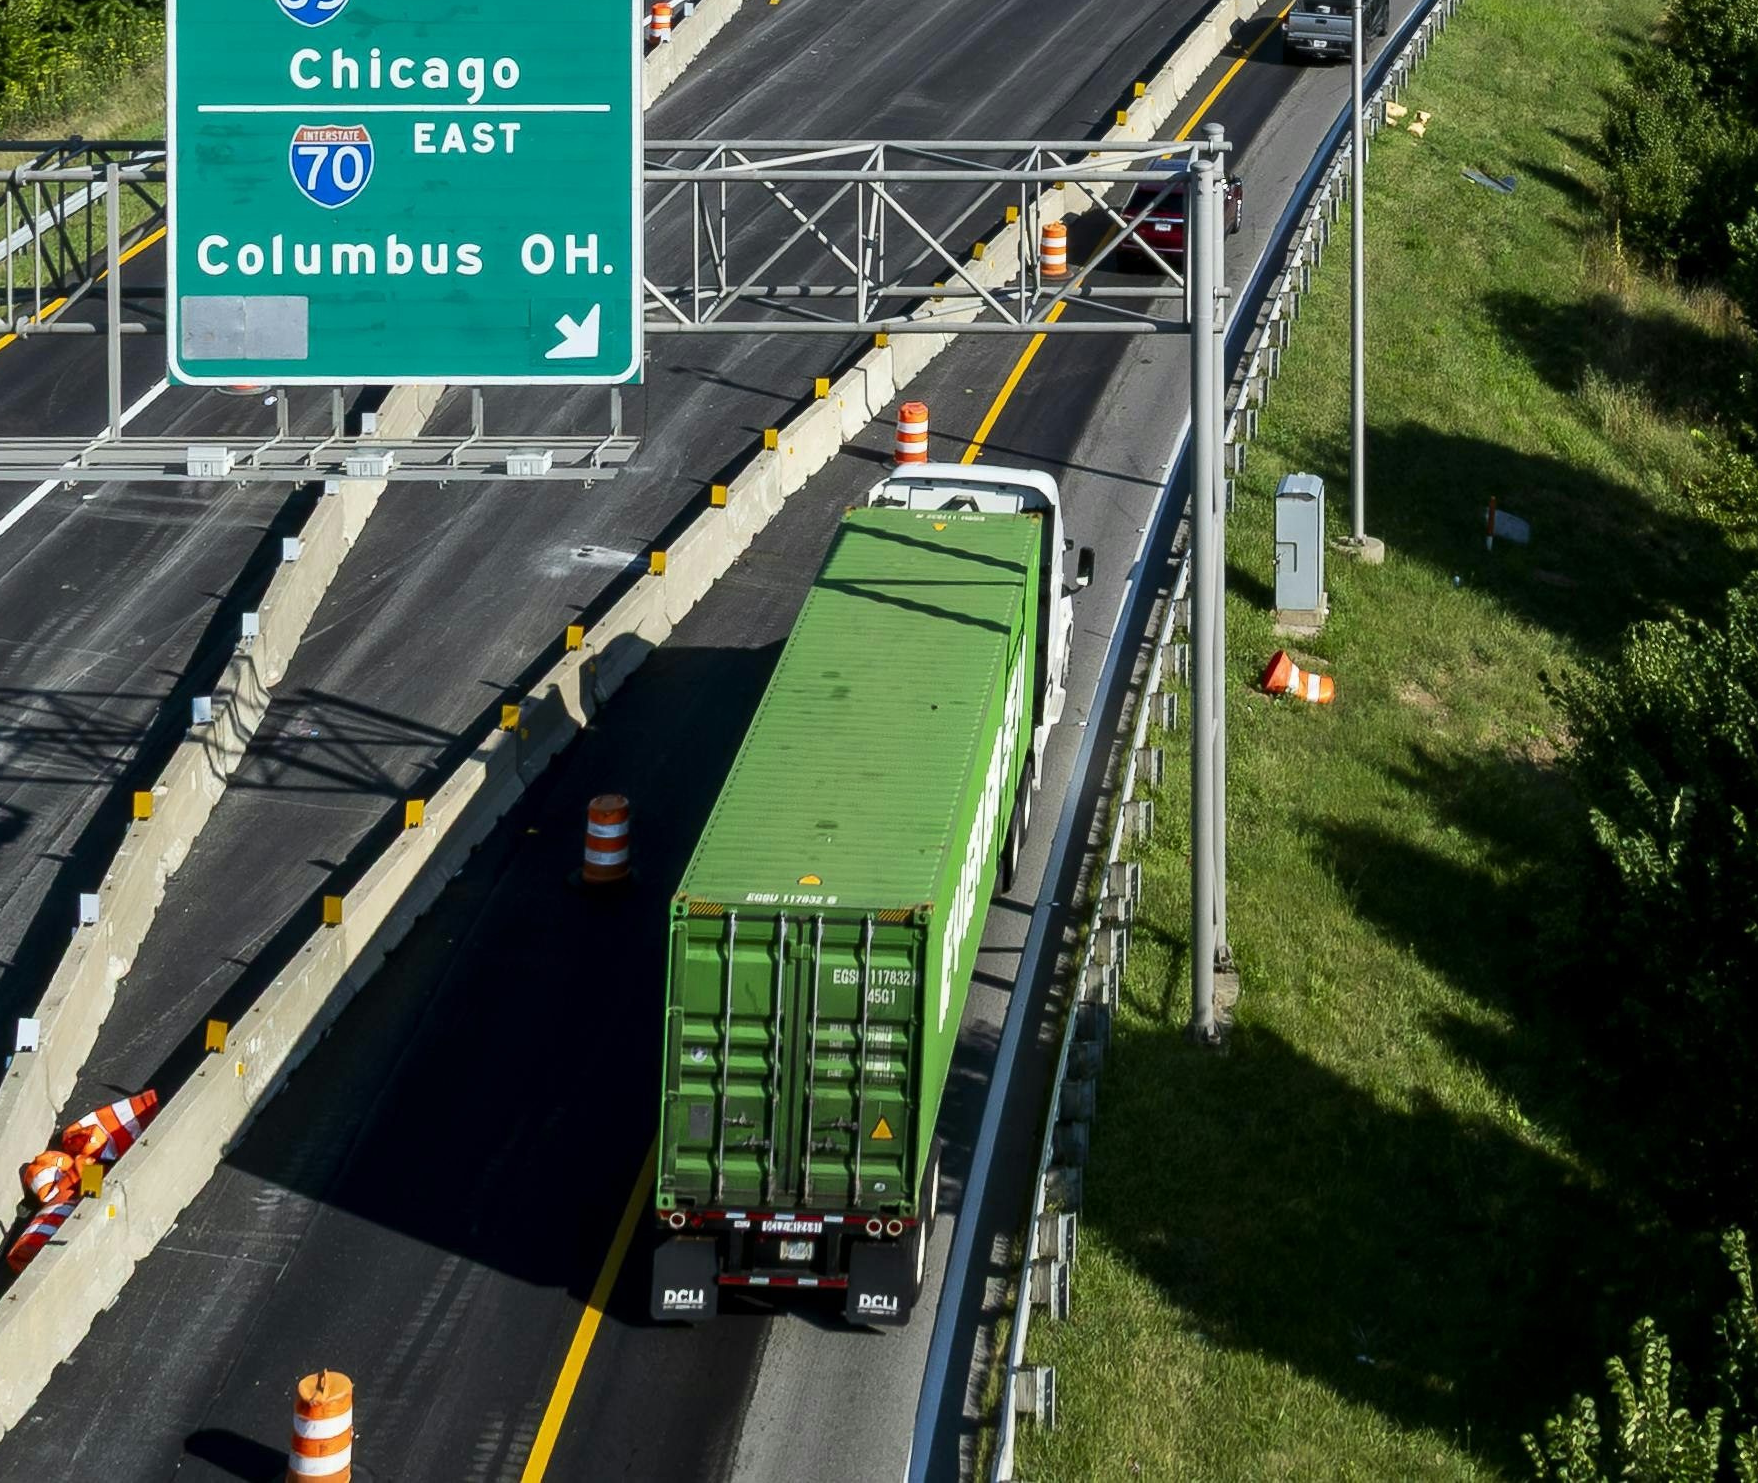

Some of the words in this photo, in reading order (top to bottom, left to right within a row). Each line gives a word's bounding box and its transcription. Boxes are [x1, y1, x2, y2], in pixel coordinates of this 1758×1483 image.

[289, 48, 520, 105] Chicago
[303, 130, 360, 141] INTERSTATE
[413, 122, 521, 154] EAST
[298, 145, 364, 192] 70
[197, 234, 483, 276] Columbus
[521, 234, 614, 275] OH.
[870, 969, 911, 987] 117832
[867, 988, 896, 1005] 45G1
[663, 1288, 704, 1304] DCLI
[858, 1293, 898, 1310] DCLI
